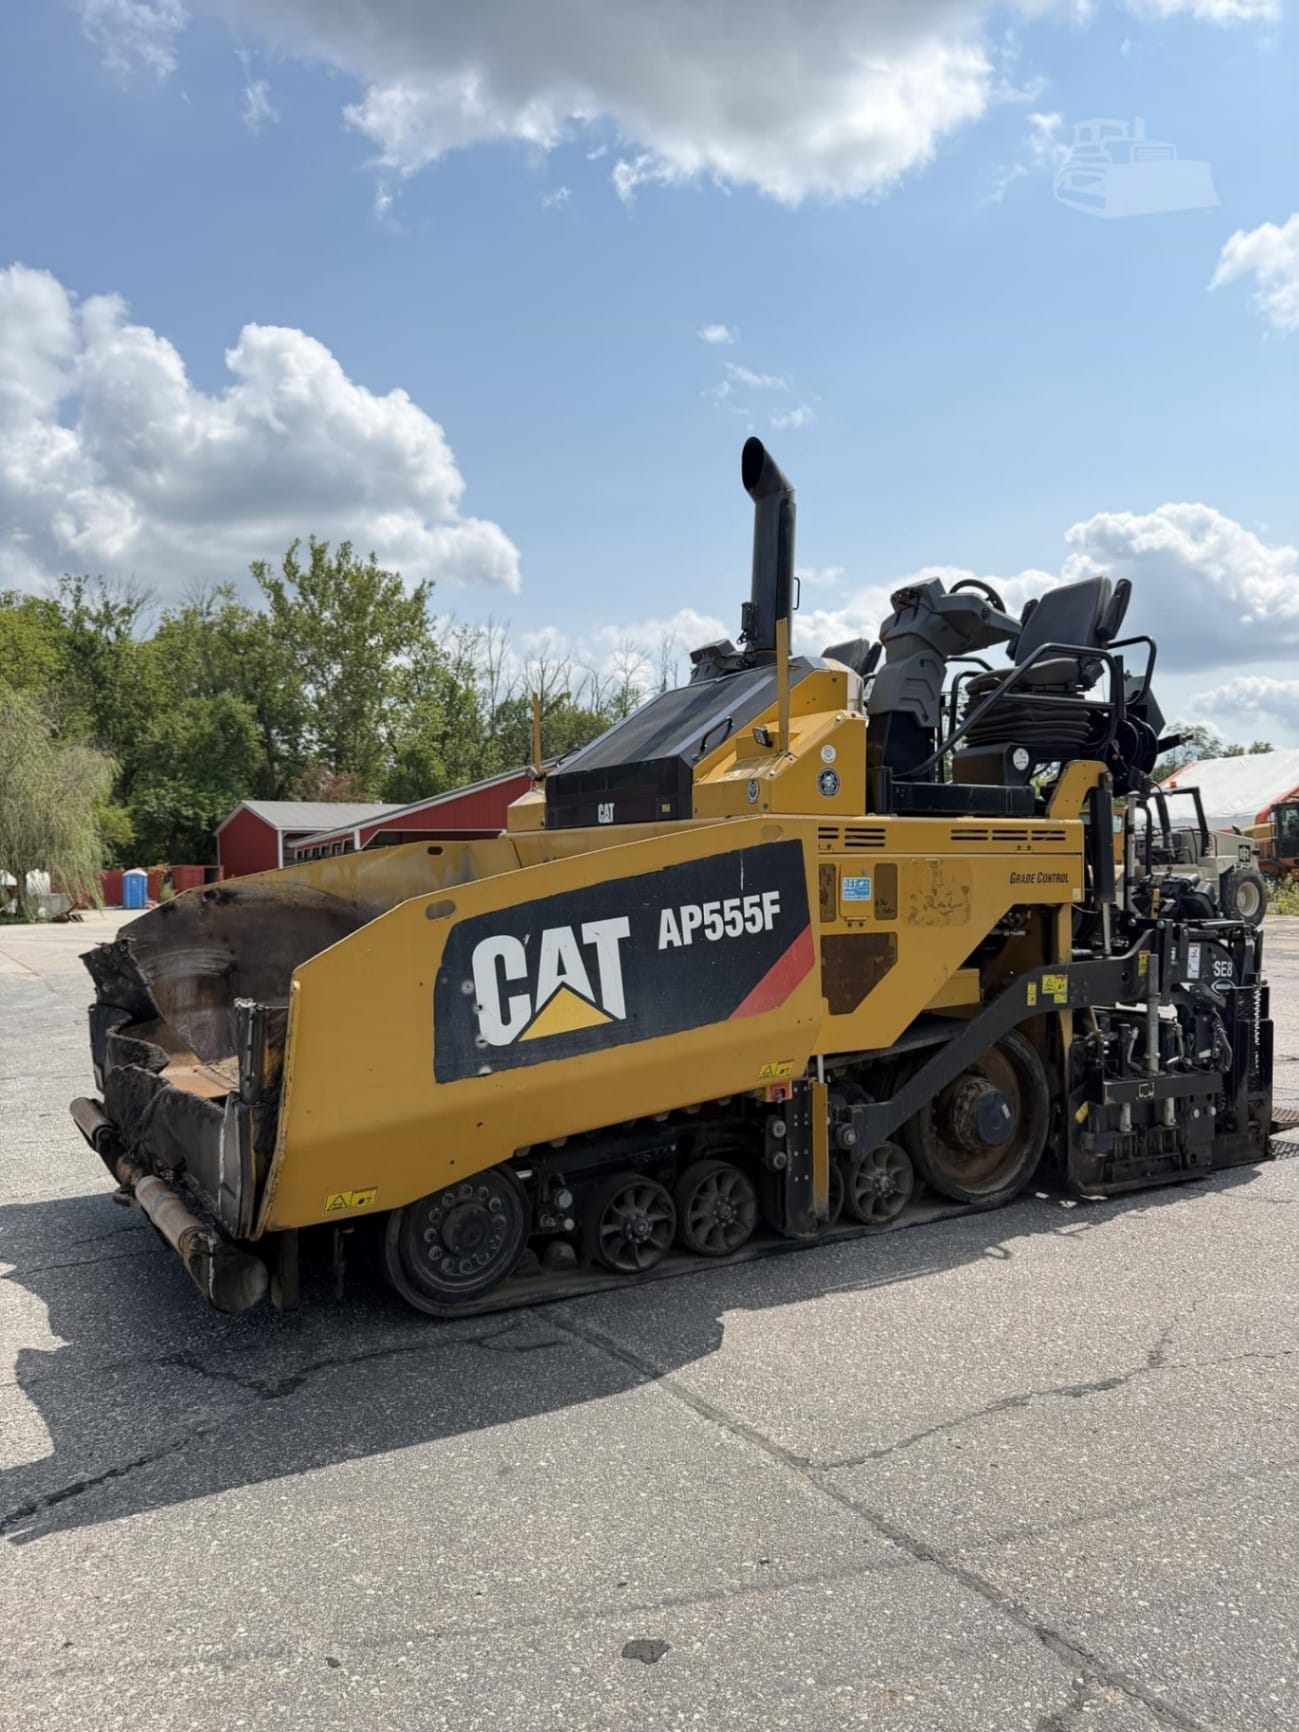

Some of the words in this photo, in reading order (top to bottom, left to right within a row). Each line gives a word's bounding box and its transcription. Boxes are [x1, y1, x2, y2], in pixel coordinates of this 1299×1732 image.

[598, 802, 615, 823] CAT
[1009, 871, 1035, 885] GRADE
[1036, 871, 1069, 884] CONTROL
[657, 891, 781, 950] AP555F
[1213, 960, 1233, 977] SE8
[471, 916, 630, 1047] CAT
